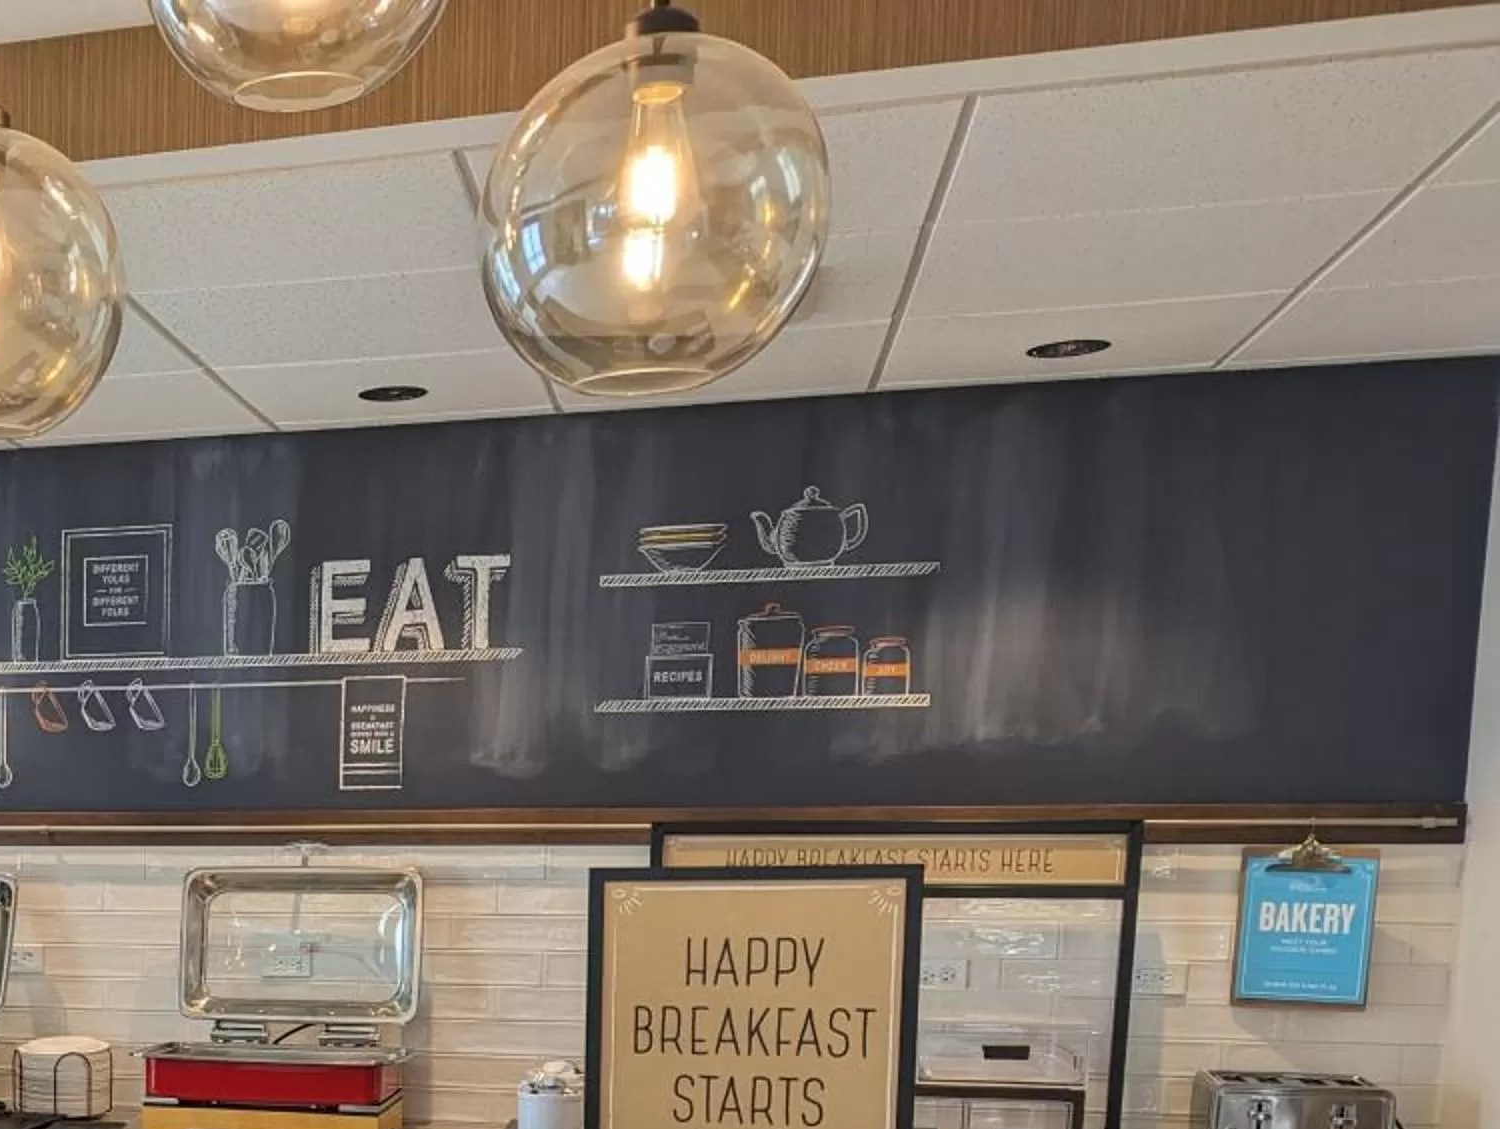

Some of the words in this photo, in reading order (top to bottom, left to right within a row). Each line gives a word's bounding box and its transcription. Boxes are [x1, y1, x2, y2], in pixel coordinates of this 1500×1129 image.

[309, 554, 511, 655] EAT
[653, 670, 703, 683] RECIPES
[349, 737, 395, 755] SMILE
[725, 848, 788, 867] HAPPY
[797, 848, 908, 867] BREAKFAST
[917, 847, 991, 872] STARTS
[1000, 847, 1054, 873] HERE
[1259, 900, 1356, 935] BAKERY
[685, 936, 825, 987] HAPPY
[633, 1005, 877, 1059] BREAKFAST
[672, 1073, 825, 1127] STARTS
